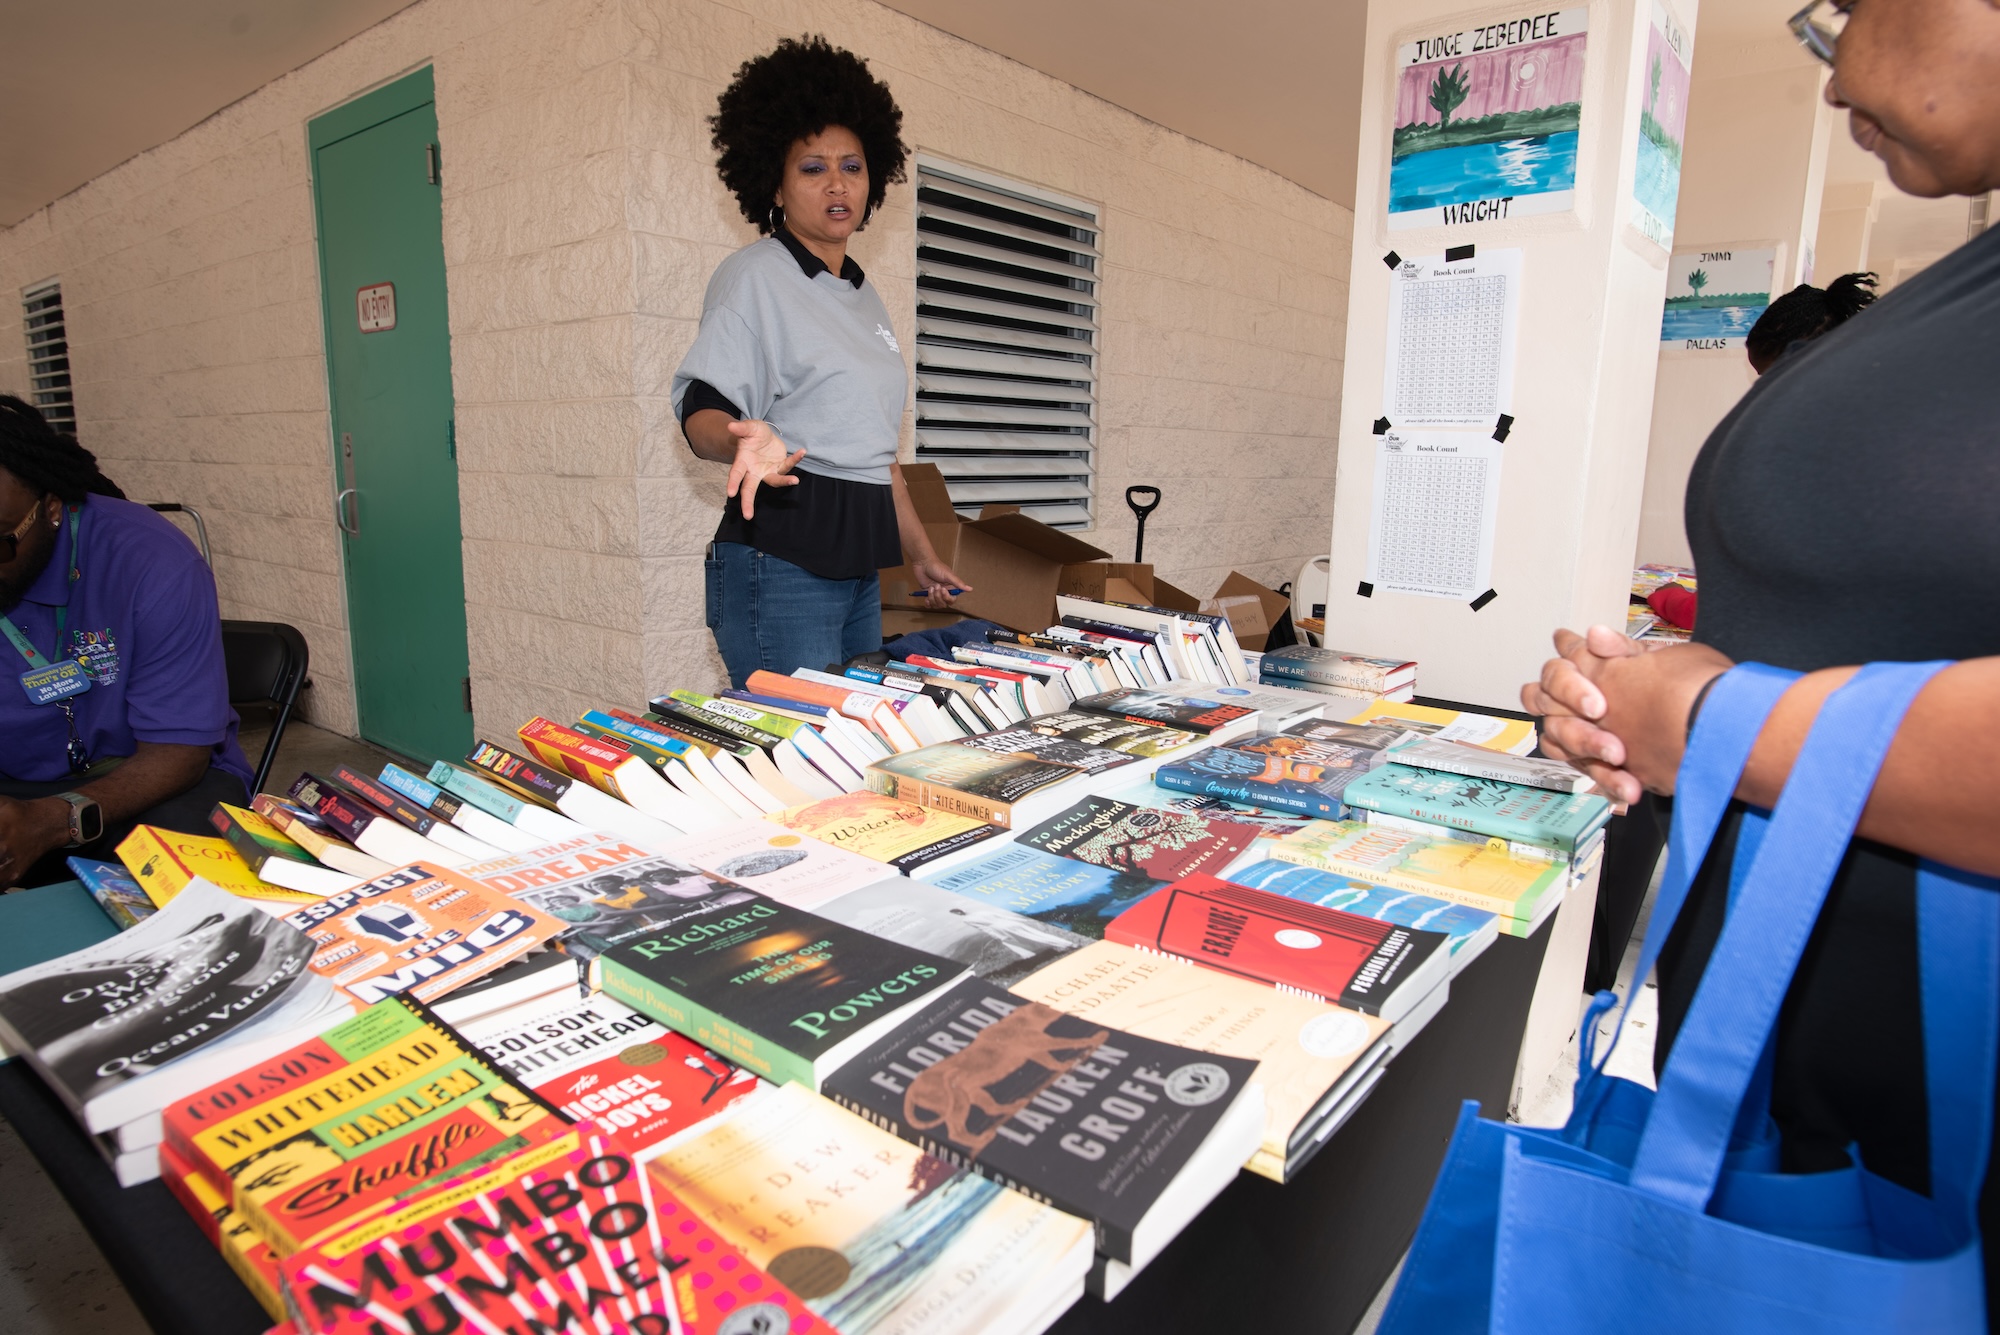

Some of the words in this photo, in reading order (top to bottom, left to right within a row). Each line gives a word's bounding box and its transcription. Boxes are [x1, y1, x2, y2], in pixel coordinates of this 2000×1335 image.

[1412, 33, 1463, 63] JUDGE
[1472, 12, 1560, 53] ZEBEDEE
[1443, 197, 1513, 226] WRIGHT
[1433, 269, 1452, 277] Book
[1453, 267, 1476, 276] Count
[1699, 250, 1734, 263] JIMMY
[1686, 338, 1727, 350] DALLAS
[1416, 445, 1435, 453] Book
[1185, 613, 1211, 623] WATCH
[38, 690, 58, 702] Late
[58, 681, 83, 695] Fines!
[39, 686, 52, 695] No
[53, 678, 74, 689] More
[60, 668, 80, 679] OK!
[849, 670, 871, 679] UNFOLLOW
[857, 664, 881, 674] MICHAEL
[881, 669, 922, 682] CUNNINGHAM
[1278, 665, 1289, 675] WE
[1291, 667, 1305, 677] ARE
[1307, 669, 1323, 679] NOT
[1325, 672, 1347, 683] FROM
[1350, 676, 1370, 687] HERE
[685, 704, 713, 722] MAZE
[709, 714, 755, 737] RUNNER
[707, 701, 758, 719] CONCEALED
[670, 724, 690, 733] COLD
[692, 731, 719, 743] BLOOD
[1164, 776, 1176, 784] ROSEN
[1205, 781, 1231, 797] Coming
[1230, 786, 1238, 797] of
[1236, 786, 1250, 802] Age
[1395, 755, 1422, 766] THE
[1423, 759, 1469, 775] SPEECH
[1481, 770, 1505, 779] GARY
[1507, 775, 1546, 787] YOUNGE
[830, 806, 930, 841] Watershed
[936, 793, 954, 810] KITE
[955, 799, 990, 821] RUNNER
[1030, 831, 1051, 845] TO
[1055, 811, 1089, 833] KILL
[1090, 801, 1100, 811] A
[1045, 801, 1127, 854] Mockingbird
[1409, 808, 1427, 819] YOU
[1431, 813, 1448, 823] ARE
[1452, 817, 1475, 828] HERE
[461, 855, 523, 878] MORE
[527, 837, 591, 859] THAN
[593, 833, 614, 842] A
[898, 838, 956, 865] PERCIVAL
[956, 824, 994, 846] EVERETT
[1177, 850, 1214, 879] HARPER
[1212, 834, 1230, 851] LEE
[480, 843, 651, 895] DREAM
[1008, 870, 1093, 910] MEMORY
[1277, 853, 1299, 863] HOW
[1302, 858, 1314, 867] TO
[1317, 863, 1345, 875] LEAVE
[1347, 868, 1388, 884] HIALEAH
[1396, 881, 1431, 895] JENNINE
[1457, 894, 1491, 908] CRUCET
[283, 865, 437, 933] ESPECT
[395, 929, 464, 961] THE
[628, 903, 780, 961] Richard
[1201, 906, 1250, 958] ERASURE
[62, 980, 117, 1004] On
[126, 927, 210, 980] Earth
[345, 908, 537, 1004] MIC
[729, 963, 773, 986] TIME
[773, 952, 795, 970] OF
[797, 939, 835, 960] OUR
[750, 946, 787, 964] THE
[763, 950, 835, 986] SINGING
[1350, 951, 1383, 994] PERCIVAL
[1380, 928, 1411, 964] EVERETT
[92, 950, 241, 1031] Gorgeous
[101, 956, 210, 1014] Briefly
[605, 969, 643, 1001] Richard
[645, 989, 686, 1024] Powers
[789, 962, 939, 1041] Powers
[1042, 958, 1126, 1003] ICHAEL
[96, 1022, 211, 1078] Ocean
[207, 954, 303, 1022] Vuong
[479, 1009, 606, 1060] COLSON
[712, 1020, 730, 1037] THE
[731, 1028, 755, 1053] TIME
[1184, 1013, 1216, 1040] YEAR
[1219, 1005, 1266, 1040] THINGS
[497, 1011, 655, 1081] HITEHEAD
[698, 1025, 711, 1039] OF
[711, 1030, 732, 1051] OUR
[732, 1042, 772, 1075] SINGING
[870, 994, 1020, 1096] FLORIDA
[186, 1044, 335, 1122] COLSON
[216, 1040, 441, 1151] WHITEHEAD
[567, 1074, 600, 1096] The
[994, 1042, 1130, 1148] LAUREN
[329, 1067, 487, 1150] HARLEM
[632, 1129, 641, 1139] A
[641, 1117, 669, 1135] NOVEL
[1058, 1063, 1182, 1162] GROFF
[281, 1120, 488, 1223] Shuffle
[767, 1137, 842, 1191] DEW
[308, 1154, 631, 1326] MUMBO
